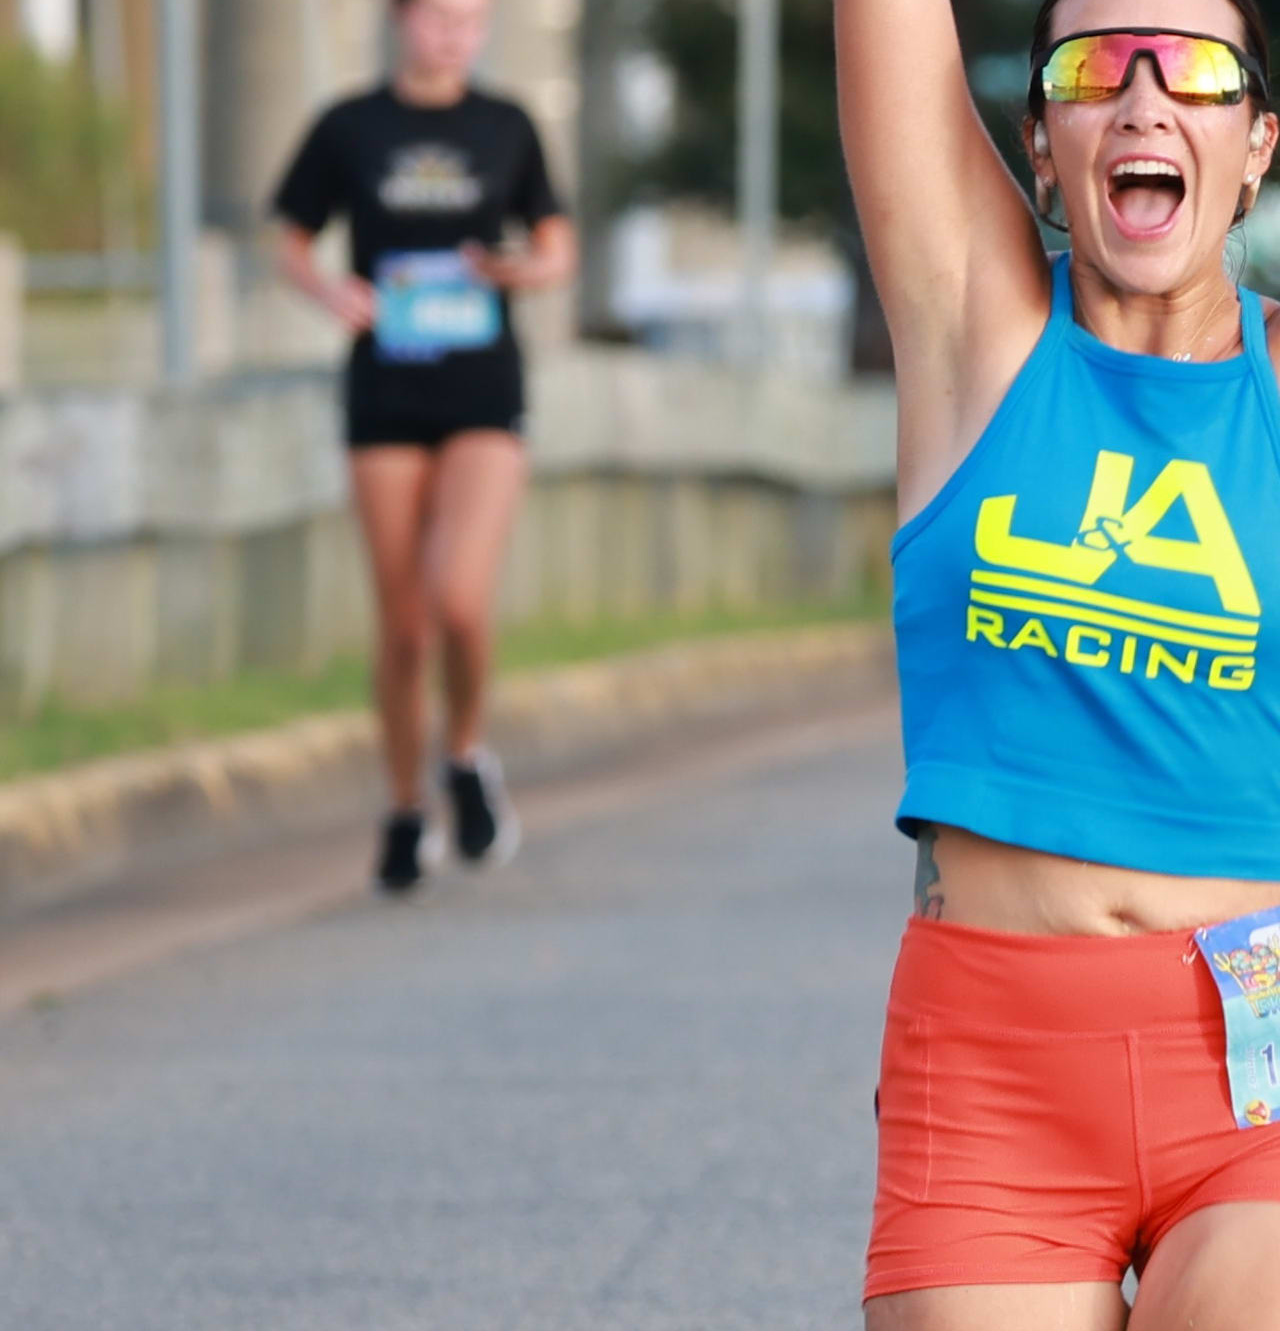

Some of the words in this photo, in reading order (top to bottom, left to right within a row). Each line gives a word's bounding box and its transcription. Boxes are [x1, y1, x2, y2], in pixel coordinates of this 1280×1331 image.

[974, 449, 1262, 618] J&A
[966, 604, 1256, 691] RACING
[1261, 1043, 1277, 1085] 1
